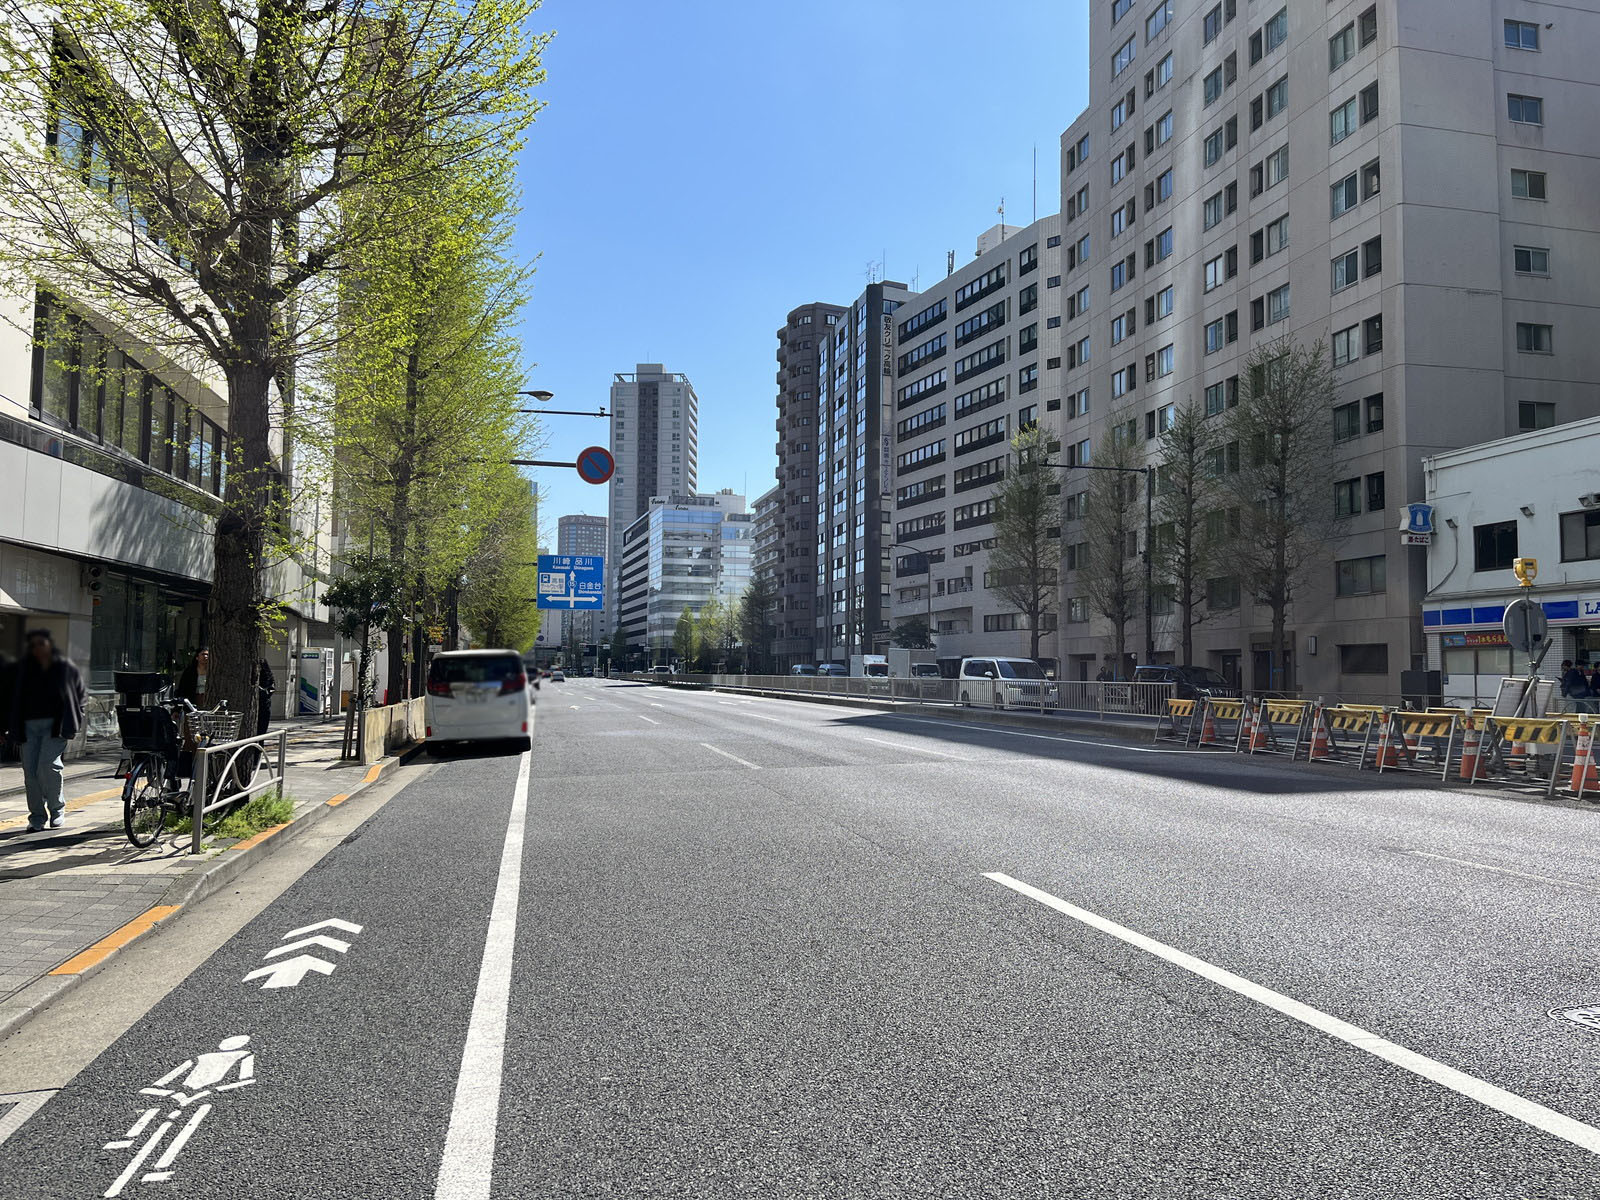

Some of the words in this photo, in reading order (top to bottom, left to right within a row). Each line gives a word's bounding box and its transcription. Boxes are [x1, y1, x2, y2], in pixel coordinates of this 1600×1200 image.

[552, 557, 570, 565] 川崎
[574, 557, 593, 566] 品川
[579, 581, 601, 590] 白金台
